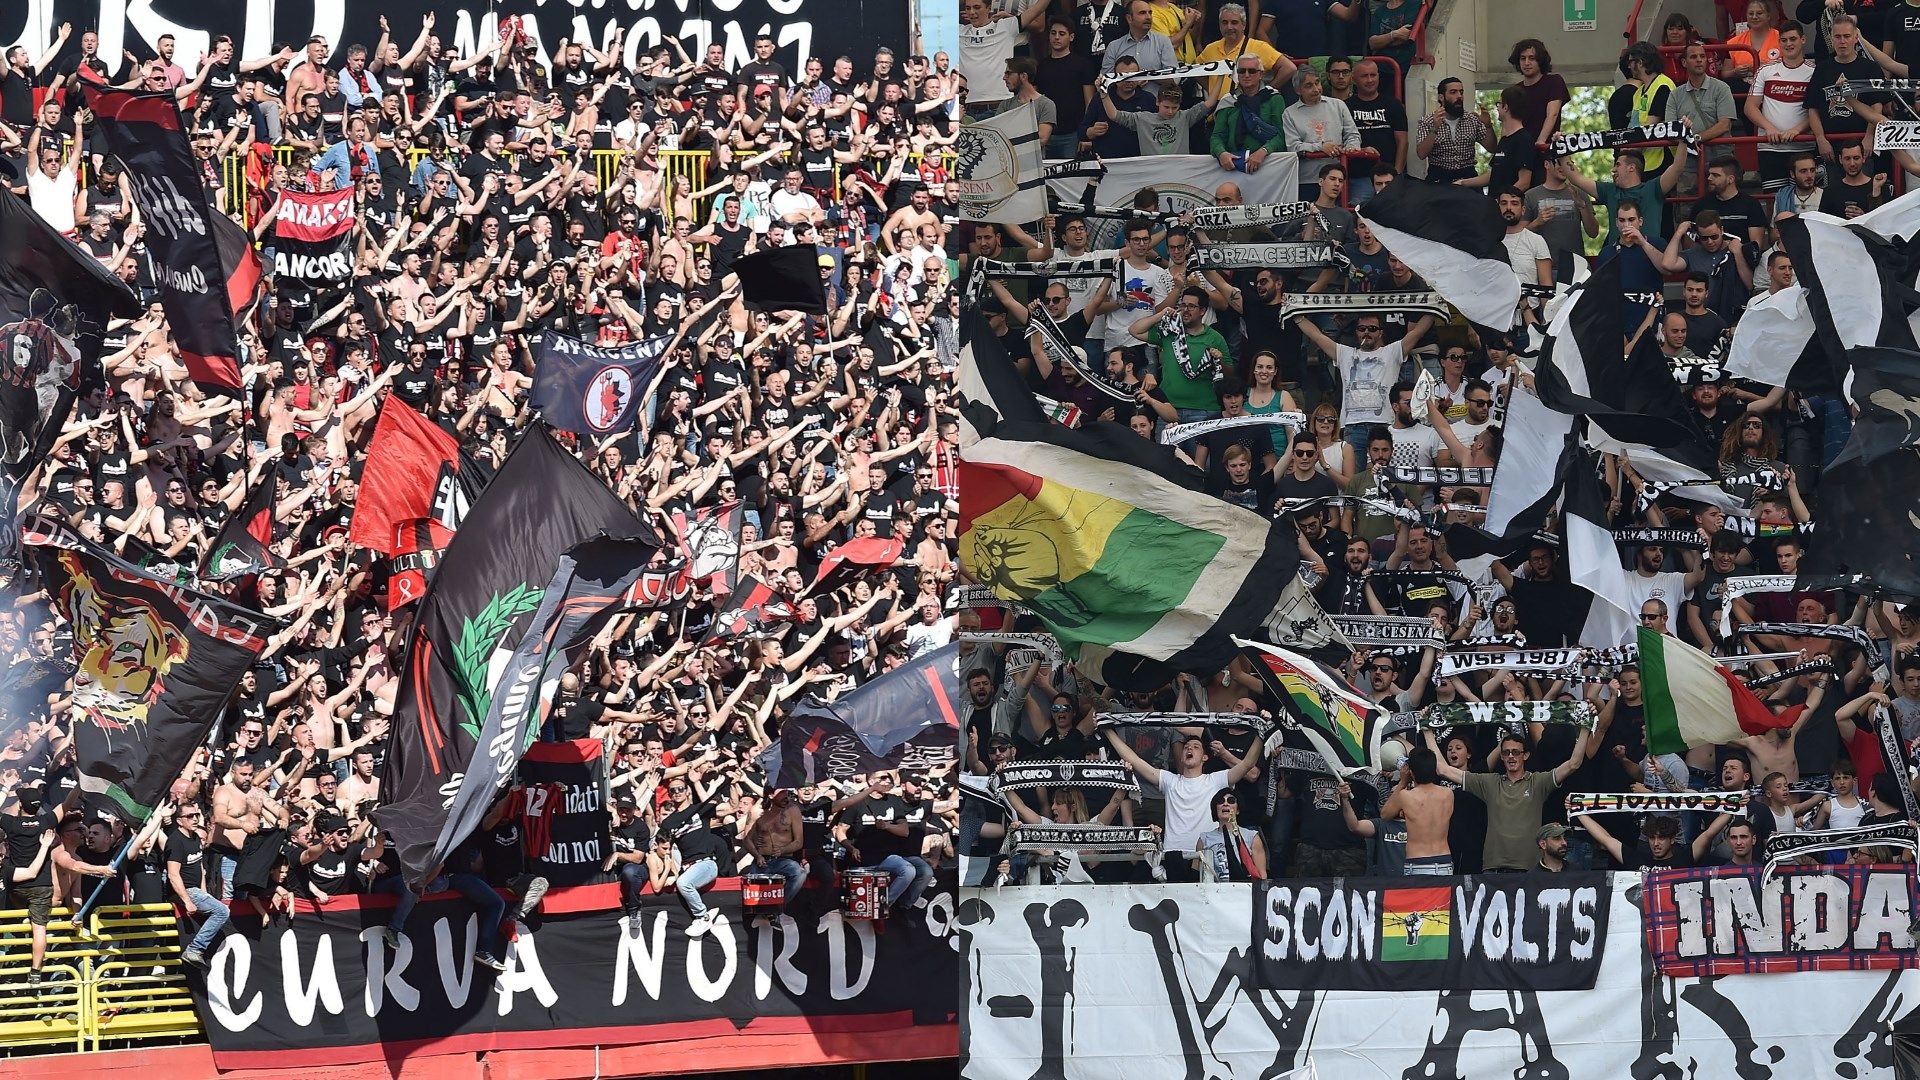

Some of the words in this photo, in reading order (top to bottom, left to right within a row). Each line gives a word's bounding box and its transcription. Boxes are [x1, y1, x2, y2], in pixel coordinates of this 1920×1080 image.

[970, 36, 984, 44] PLT
[1556, 131, 1604, 155] SCON
[1194, 212, 1232, 228] ORZA
[1271, 201, 1312, 220] CESEN
[1200, 247, 1262, 266] FORZA
[1264, 245, 1332, 265] CESENA
[1302, 294, 1354, 306] FORZA
[1367, 292, 1430, 305] CESENA
[1381, 624, 1434, 639] CESENA
[1450, 653, 1506, 669] WSB
[1465, 701, 1497, 723] W
[1505, 701, 1525, 723] S
[1530, 700, 1552, 722] B
[1003, 769, 1053, 782] MAGICO
[1081, 768, 1126, 781] CESENA
[526, 787, 548, 817] 12
[571, 831, 602, 863] noi
[1022, 830, 1071, 843] FORZA
[1084, 829, 1137, 843] CESENA
[1263, 886, 1377, 963] SCON
[1455, 882, 1597, 964] VOLTS
[206, 911, 560, 1033] CURVA
[611, 907, 877, 1007] NORD
